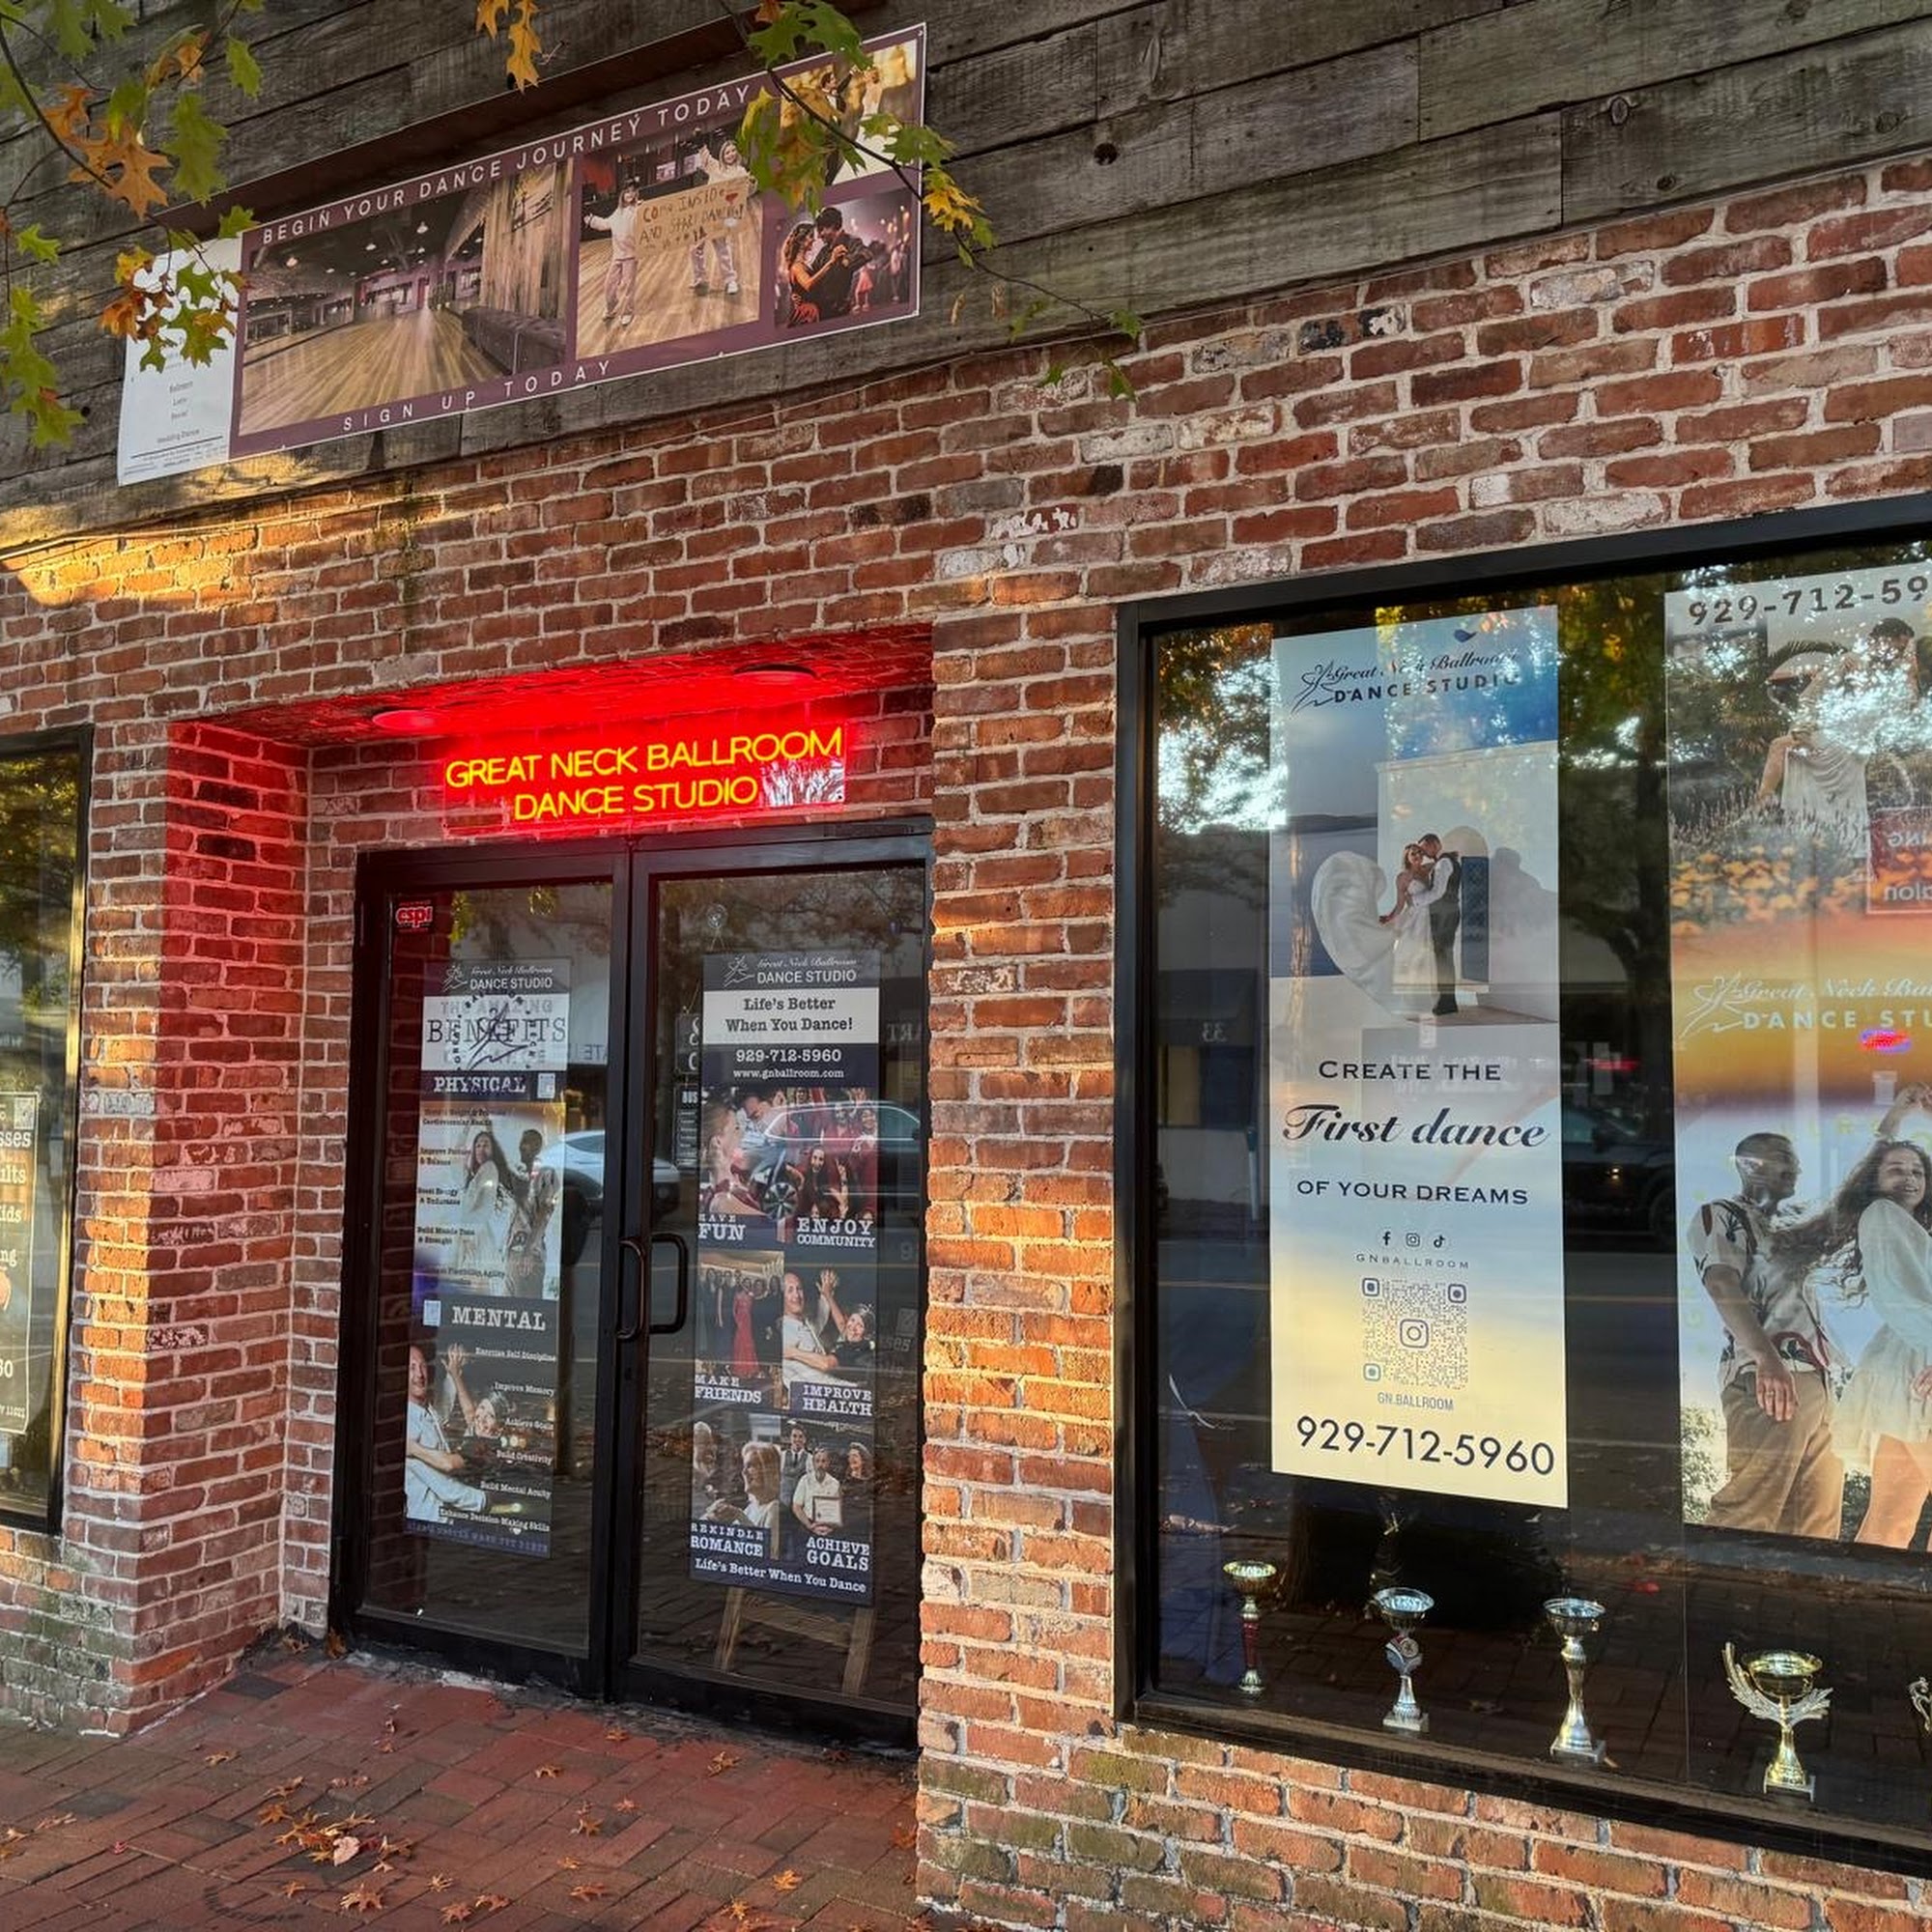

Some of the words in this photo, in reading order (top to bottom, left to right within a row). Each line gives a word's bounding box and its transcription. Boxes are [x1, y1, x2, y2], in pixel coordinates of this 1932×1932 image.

[263, 212, 330, 244] BEGIN
[344, 189, 405, 220] YOUR
[419, 160, 502, 198] DANCE
[516, 116, 641, 170] JOURNEY
[657, 84, 750, 127] TODAY
[343, 404, 413, 431] SIGN
[440, 390, 476, 411] UP
[503, 360, 611, 397] TODAY
[1332, 666, 1378, 684] Great
[1334, 682, 1412, 703] DANCE
[446, 754, 542, 788] GREAT
[550, 746, 639, 779] NECK
[646, 726, 842, 771] BALLROOM
[514, 785, 625, 821] DANCE
[632, 776, 758, 812] STUDIO
[469, 978, 508, 990] DANCE
[510, 977, 554, 989] STUDIO
[756, 971, 803, 984] DANCE
[806, 969, 857, 982] STUDIO
[743, 998, 784, 1011] Life's
[788, 996, 836, 1010] Better
[726, 1018, 768, 1032] When
[772, 1018, 799, 1032] You
[801, 1017, 853, 1031] Dance!
[1743, 1010, 1857, 1030] DANCE
[735, 1048, 842, 1063] 929-712-5960
[733, 1067, 844, 1080] www.gnballroom.com
[434, 1076, 526, 1094] PHYSICAL
[1283, 1103, 1404, 1143] First
[1411, 1107, 1550, 1148] dance
[1296, 1180, 1330, 1195] OF
[1338, 1181, 1406, 1199] YOUR
[1416, 1185, 1528, 1205] DREAMS
[697, 1223, 747, 1241] FUN
[796, 1216, 874, 1236] ENJOY
[796, 1235, 876, 1248] COMMUNITY
[1355, 1253, 1469, 1270] GNBALLROOM
[451, 1305, 547, 1331] MENTAL
[694, 1375, 740, 1387] MAKE
[694, 1385, 762, 1405] FRIENDS
[802, 1384, 872, 1401] IMPROVE
[1378, 1392, 1455, 1410] GN.BALLROOM
[802, 1397, 873, 1416] HEALTH
[1296, 1415, 1554, 1475] 929-712-5960
[690, 1522, 764, 1542] REKINDLE
[690, 1535, 763, 1558] ROMANCE
[806, 1536, 870, 1556] ACHIEVE
[806, 1549, 869, 1572] GOALS
[695, 1557, 726, 1573] Life's
[728, 1562, 767, 1578] Better
[768, 1568, 803, 1584] When
[804, 1574, 827, 1587] You
[828, 1577, 867, 1593] Dance
